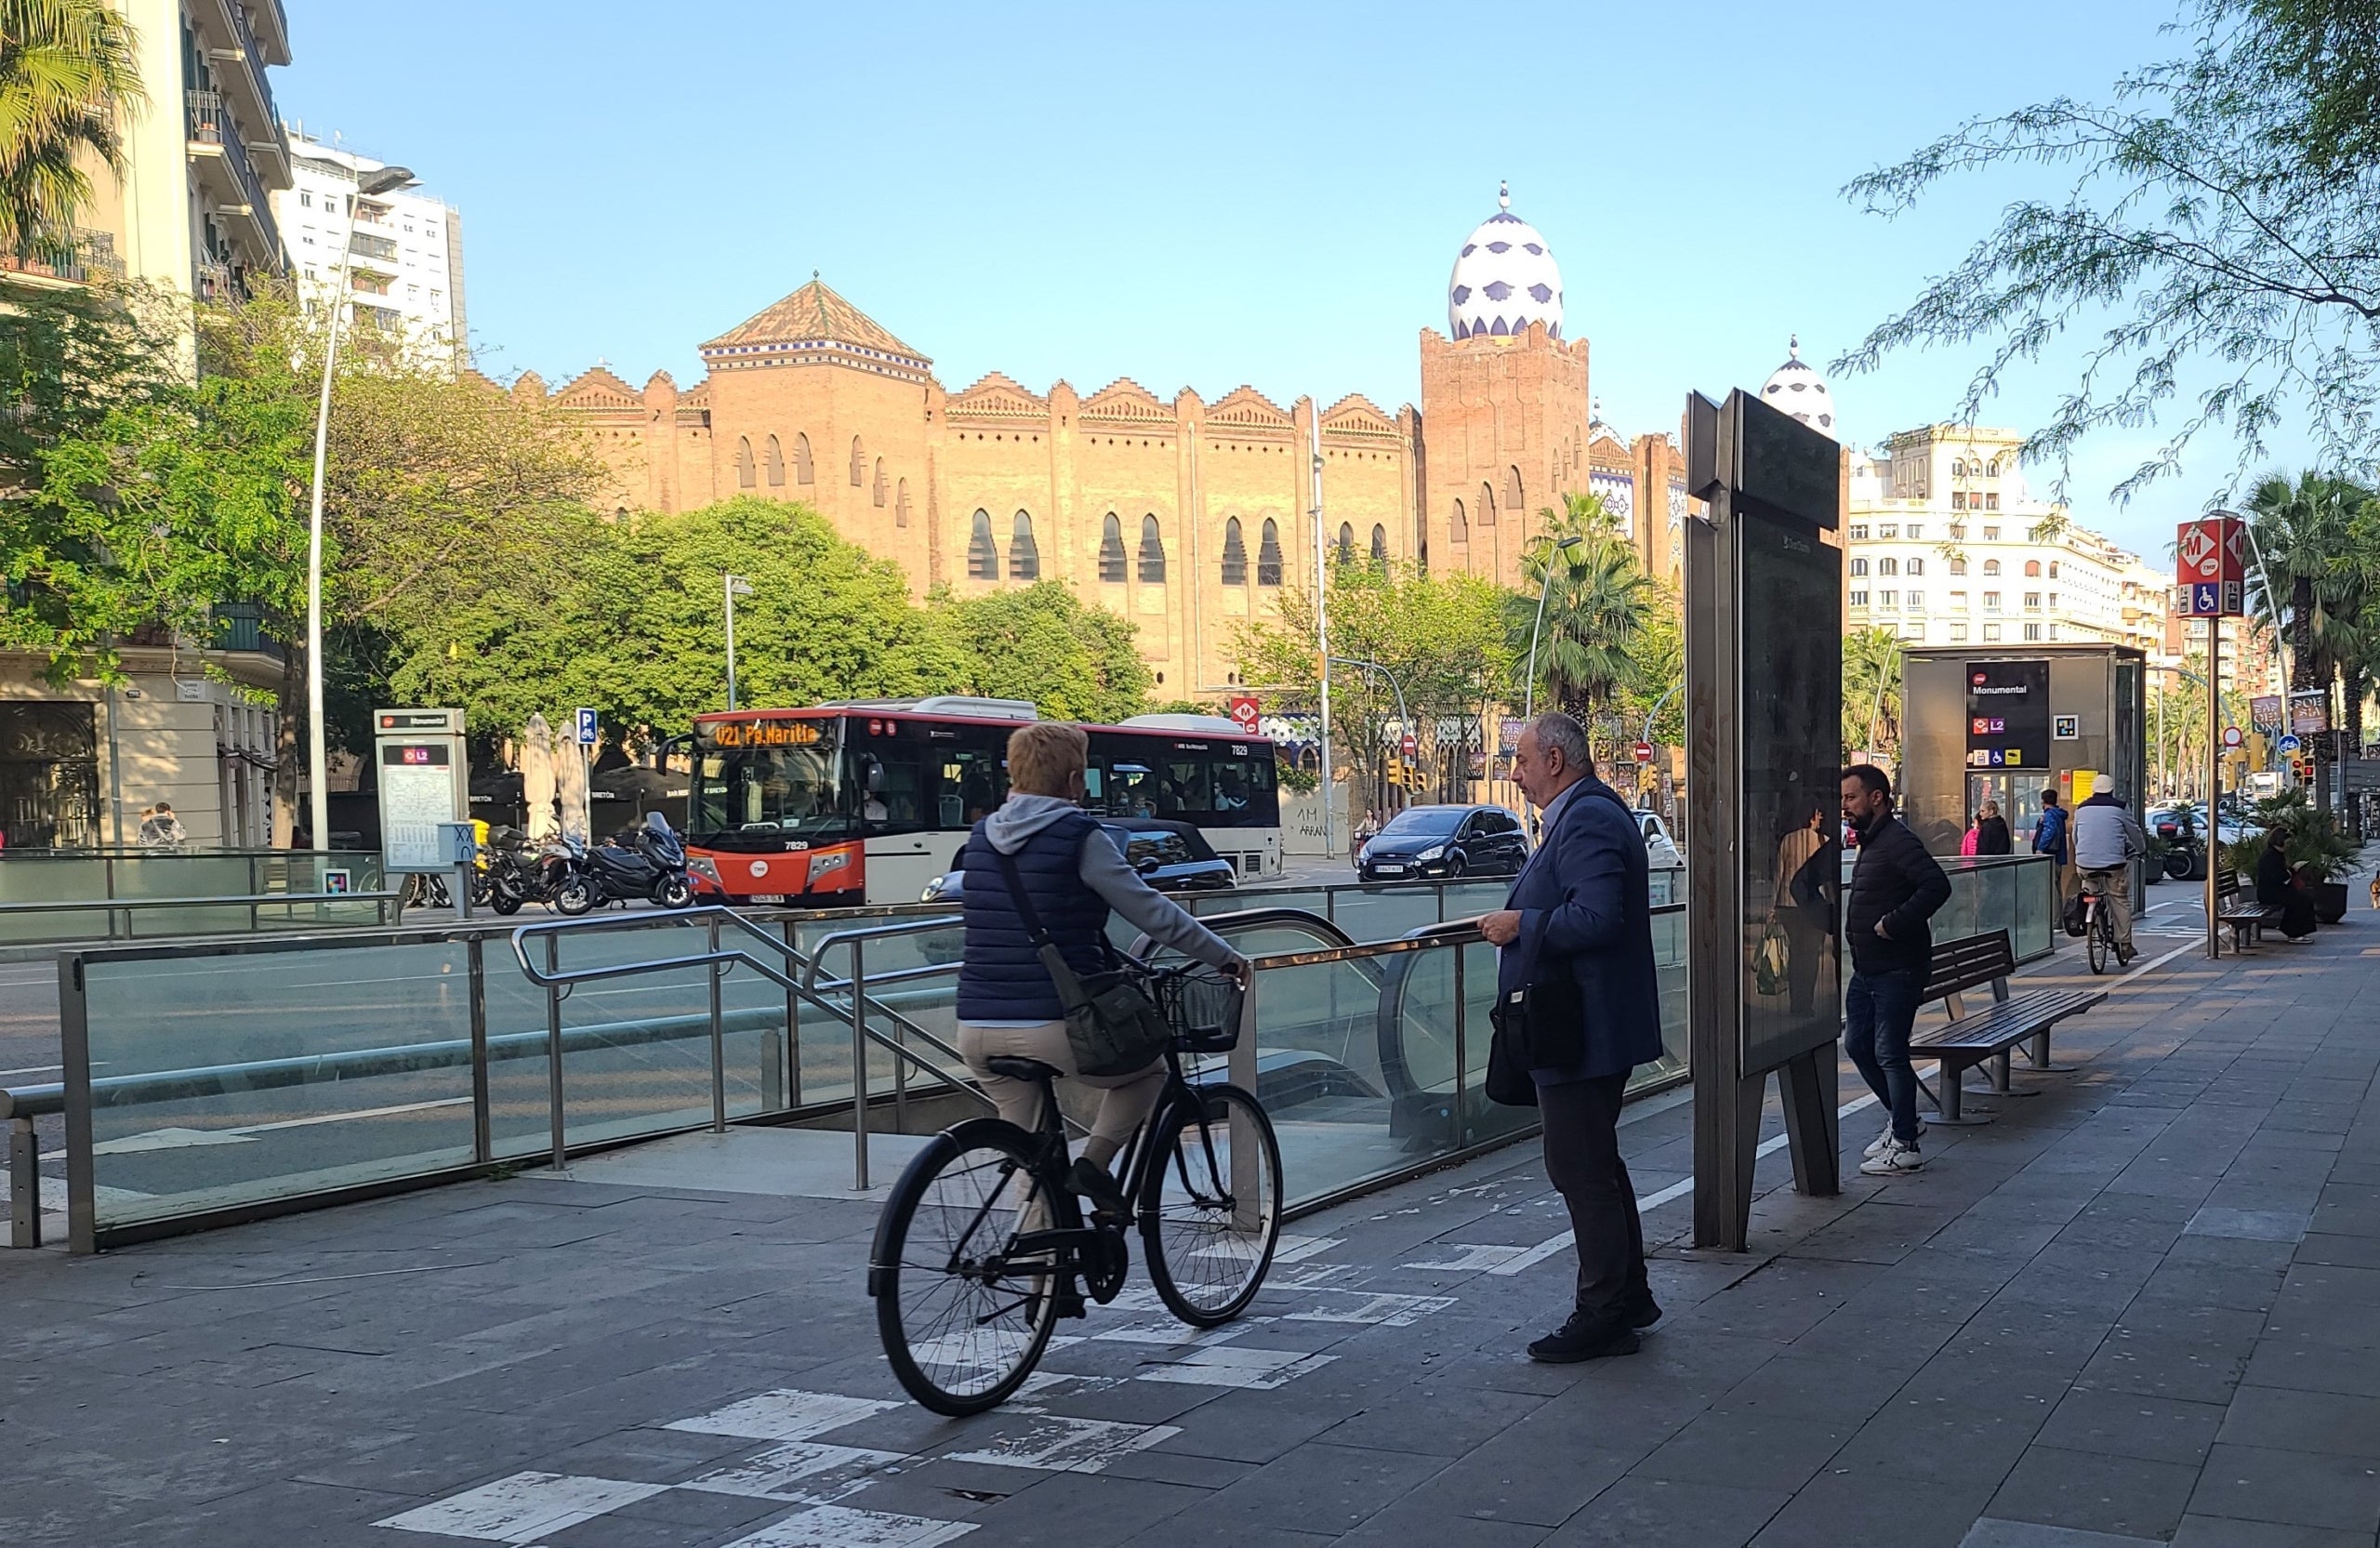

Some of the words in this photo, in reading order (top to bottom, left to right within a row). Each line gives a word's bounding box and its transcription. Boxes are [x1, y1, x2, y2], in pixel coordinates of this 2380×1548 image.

[2186, 536, 2202, 557] M
[1973, 685, 2027, 695] Monumental
[1241, 708, 1250, 717] M
[583, 713, 592, 727] P
[1990, 721, 2004, 731] L2
[1231, 745, 1249, 756] 7829
[416, 751, 429, 761] L2
[785, 840, 809, 850] 7829
